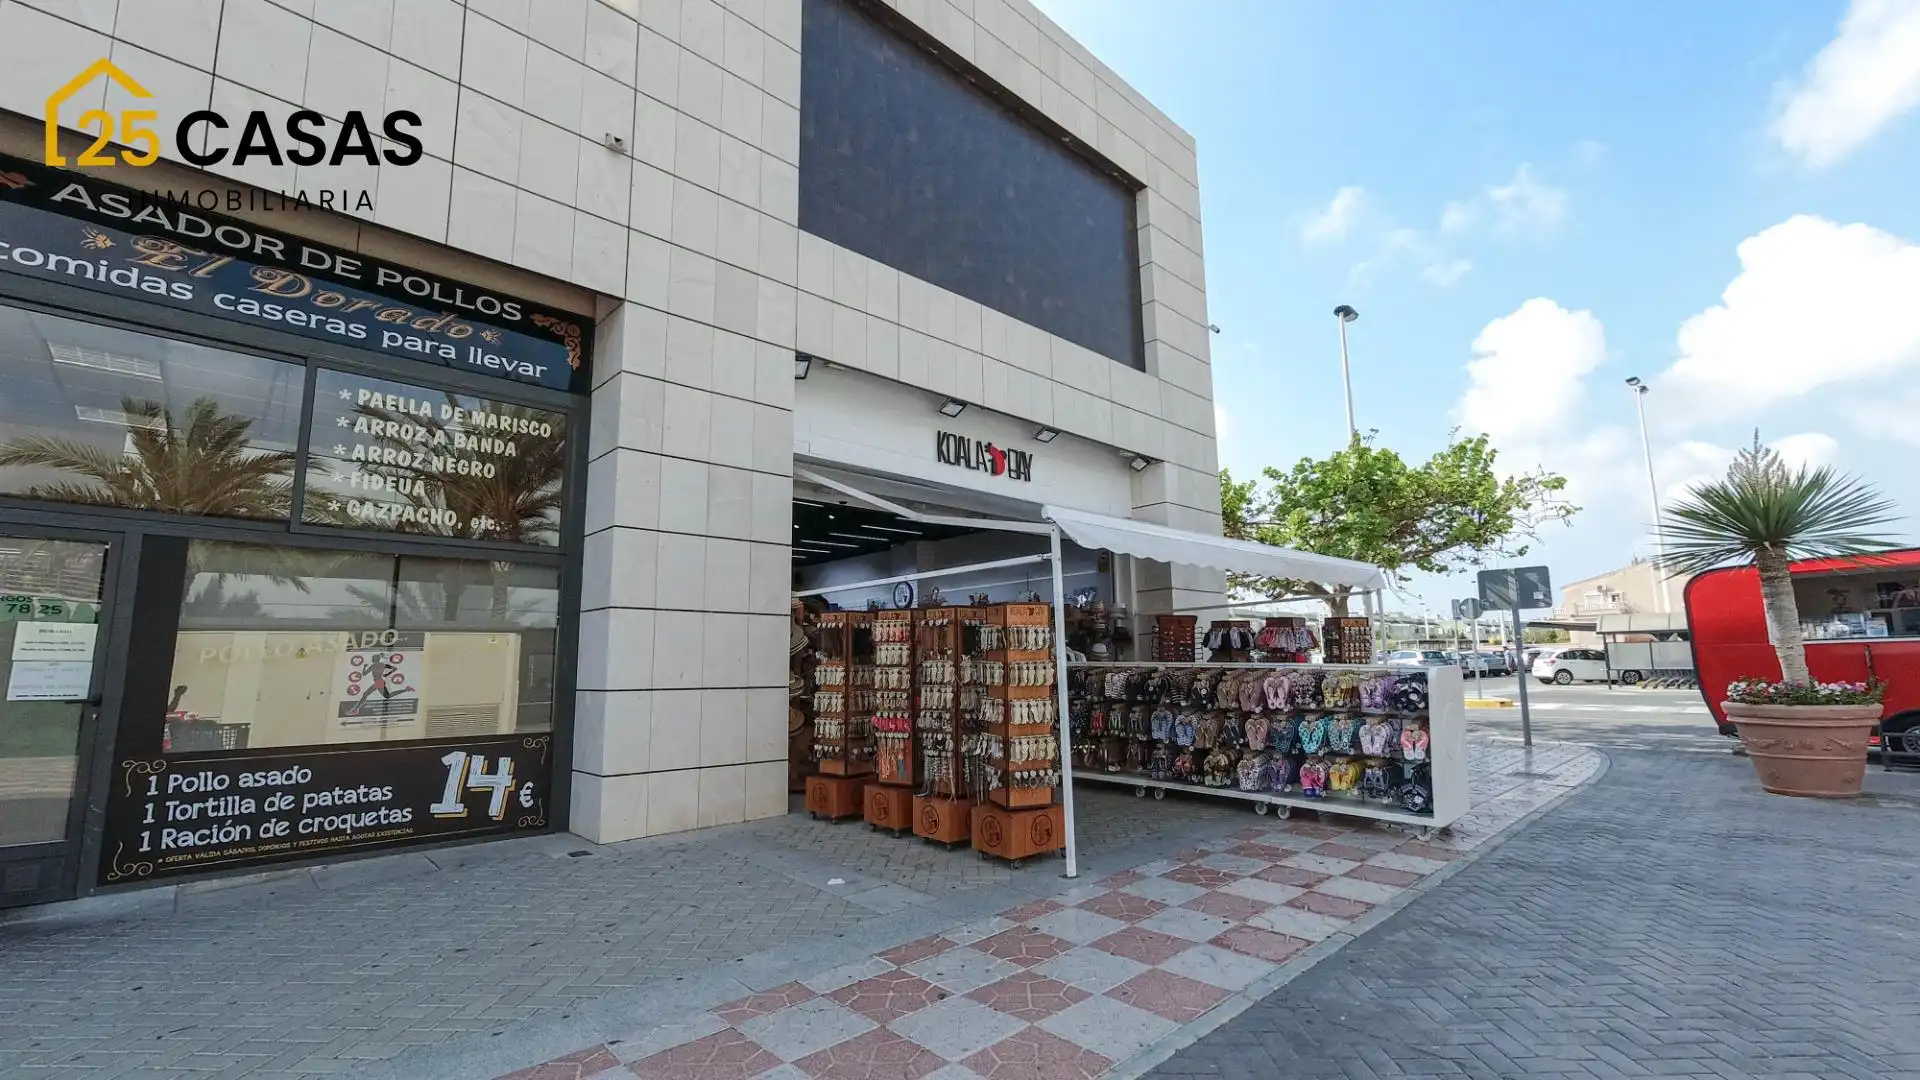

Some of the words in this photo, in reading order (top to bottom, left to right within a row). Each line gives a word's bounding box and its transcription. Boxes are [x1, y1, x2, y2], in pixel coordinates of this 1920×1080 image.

[50, 182, 287, 261] ASADOR
[300, 246, 363, 280] DE
[376, 267, 522, 322] POLLOS
[125, 234, 236, 278] El
[247, 265, 474, 341] Dorado
[213, 293, 368, 340] caseras
[382, 329, 457, 360] para
[468, 346, 548, 378] llevar
[357, 388, 432, 417] PAELLA
[440, 403, 464, 423] DE
[471, 410, 551, 438] MARISCO
[353, 416, 427, 442] ARROZ
[433, 429, 448, 446] A
[454, 433, 516, 457] BANDA
[936, 430, 988, 473] KOALA
[1007, 448, 1033, 482] BAY
[351, 443, 426, 470] ARROZ
[431, 456, 496, 479] NEGRO
[346, 499, 463, 530] GAZPACHO,
[0, 595, 34, 603] GOS
[38, 603, 63, 615] 25
[146, 775, 159, 796] 1
[167, 771, 230, 794] Pollo
[238, 766, 312, 788] asado
[430, 751, 517, 821] 14
[519, 781, 534, 808] €
[142, 802, 156, 825] 1
[165, 795, 257, 822] Tortilla
[263, 792, 295, 812] de
[302, 784, 394, 814] patatas
[138, 831, 152, 853] 1
[160, 819, 251, 850] Ración
[259, 818, 290, 839] de
[298, 806, 413, 835] croquetas
